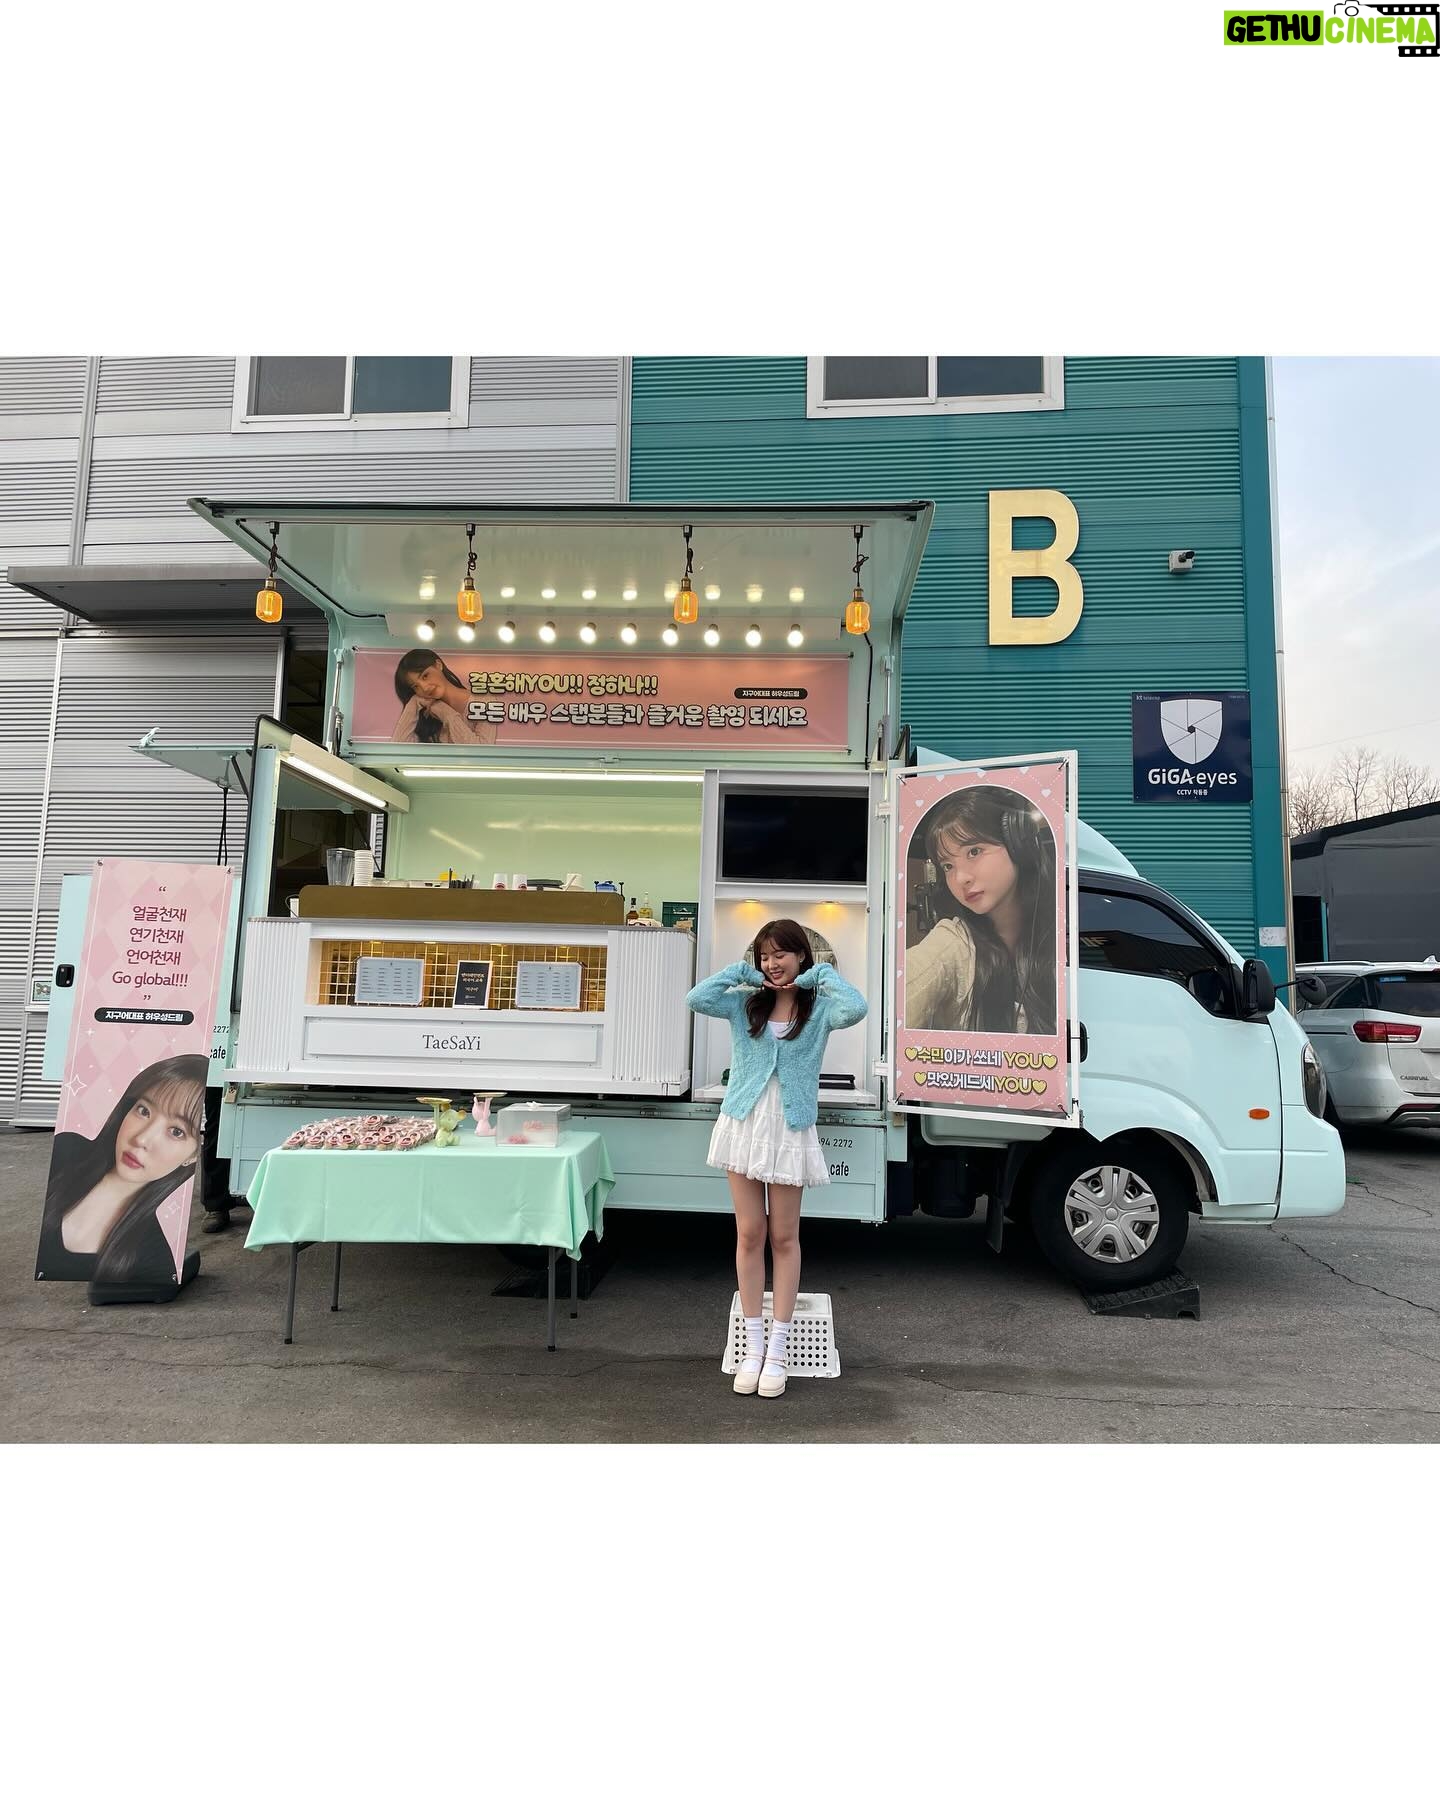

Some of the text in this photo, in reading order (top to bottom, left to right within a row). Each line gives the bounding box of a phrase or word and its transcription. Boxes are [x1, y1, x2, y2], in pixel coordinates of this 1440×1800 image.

[989, 489, 1084, 646] B
[469, 671, 658, 696] 결혼해YOU!! 정하나!!
[467, 701, 808, 728] 모든 배우 스탭분들과 즐거운 촬영 되세요
[132, 905, 187, 923] 얼굴천재
[129, 927, 184, 944] 연기천재
[126, 949, 181, 966] 언어천재
[112, 971, 188, 988] Go global!!!
[422, 1034, 481, 1051] TaeSaYi
[917, 1046, 1043, 1069] 수민이가 쏘네 YOU
[833, 1138, 853, 1149] 2272
[828, 1161, 850, 1177] cafe
